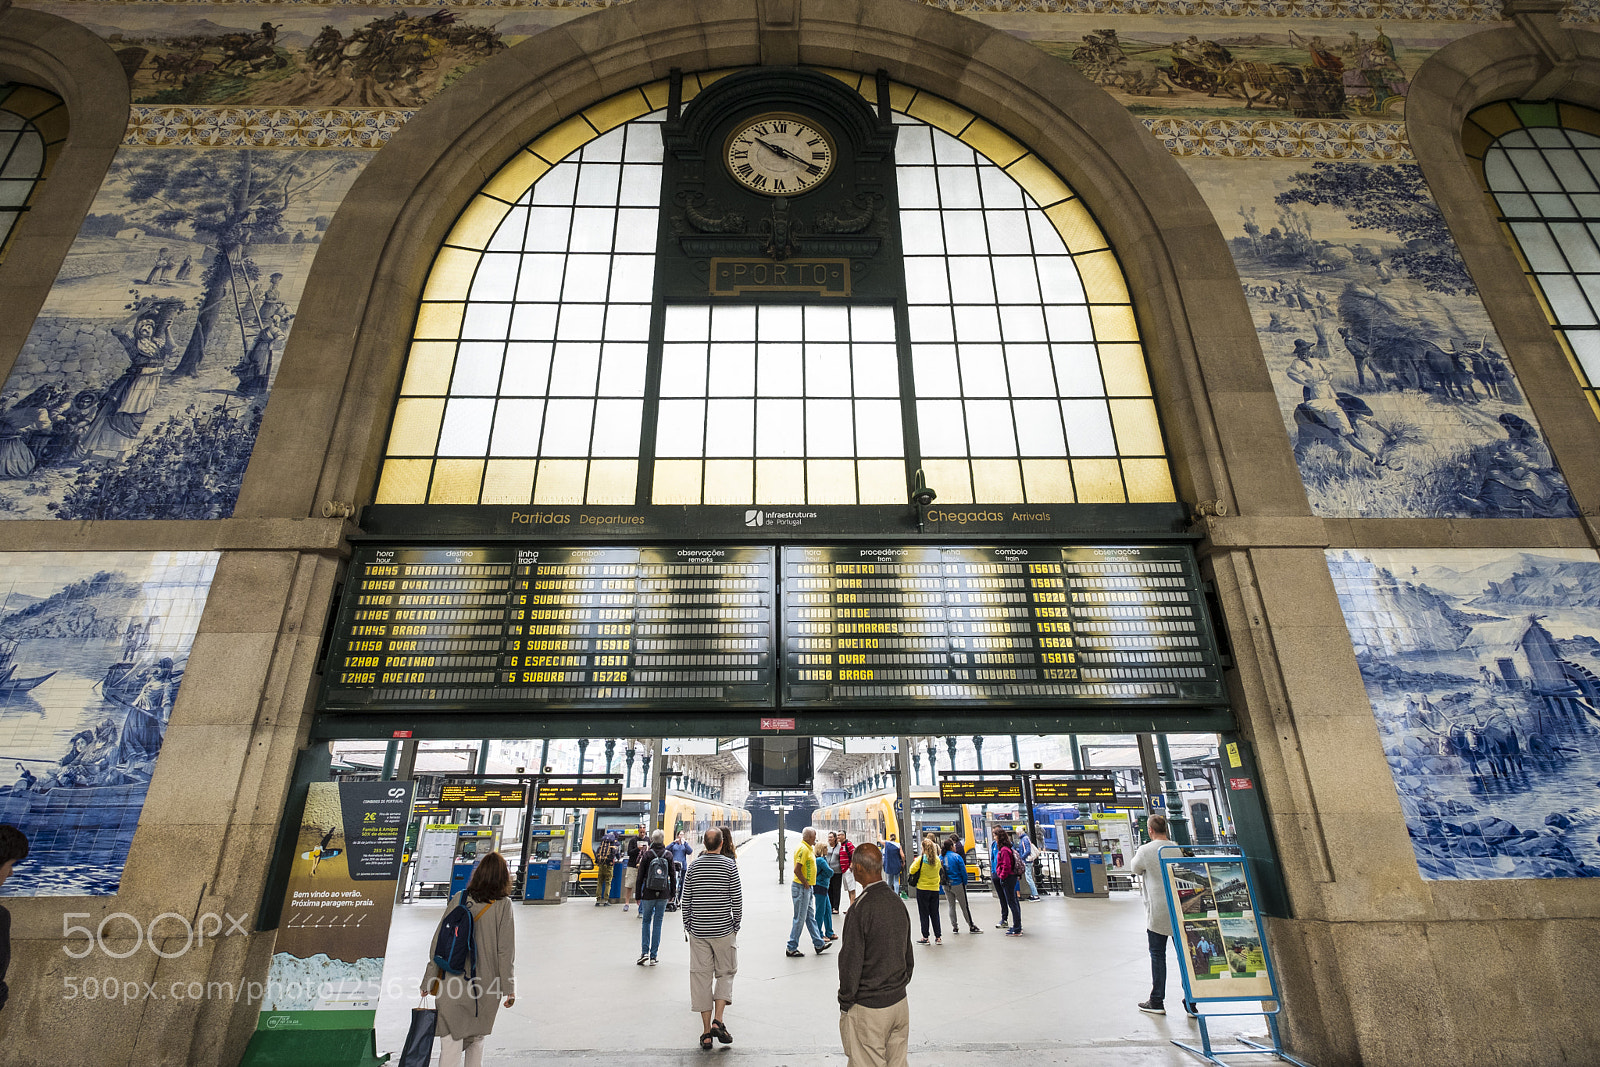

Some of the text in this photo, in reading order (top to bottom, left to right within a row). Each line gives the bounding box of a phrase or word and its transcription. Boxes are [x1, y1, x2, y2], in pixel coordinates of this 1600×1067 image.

[754, 126, 768, 136] XI
[773, 124, 786, 133] XII
[795, 128, 804, 136] I
[740, 138, 754, 146] X
[806, 138, 820, 146] II
[734, 150, 748, 158] IX
[812, 152, 825, 160] III
[738, 163, 754, 178] VIII
[752, 174, 768, 187] VII
[774, 179, 785, 189] VI
[796, 176, 806, 186] V
[733, 264, 826, 284] PORTO
[511, 512, 645, 526] Partidas Departures
[928, 510, 1051, 524] Chegadas Arrivals
[677, 550, 724, 558] observações
[365, 566, 398, 575] 10H45
[404, 566, 438, 575] BRAGA
[525, 566, 530, 575] 1
[836, 564, 874, 574] AVEIRO
[1029, 564, 1060, 573] 15616
[361, 580, 395, 590] 10H50
[402, 580, 428, 590] OVAR
[522, 580, 528, 590] 4
[836, 579, 862, 588] OVAR
[358, 595, 392, 604] 11H00
[399, 595, 452, 604] PENAFIEL
[520, 595, 526, 604] 5
[533, 595, 574, 604] SUBURB
[837, 594, 856, 602] BRA
[1033, 593, 1066, 602] 15220
[354, 610, 389, 620] 11H05
[396, 610, 437, 620] AVEIRO
[518, 610, 524, 620] 3
[531, 610, 571, 620] SUBURB
[1035, 608, 1068, 617] 15522
[352, 626, 386, 635] 11H45
[392, 626, 426, 635] BRAGA
[516, 626, 522, 635] 4
[529, 626, 570, 634] SUBURB
[838, 623, 898, 633] GUIMARAES
[1037, 622, 1070, 632] 15158
[348, 640, 630, 650] 11H50 OVAR 3 SUBURB 15918
[838, 638, 878, 648] AVEIRO
[1040, 638, 1073, 648] 15620
[345, 656, 628, 666] 12H00 POCINHO 6 ESPECIAL 13511
[839, 654, 866, 664] OVAR
[1042, 654, 1076, 664] 15816
[340, 672, 627, 683] 12H05 AVEIRO 5 SUBURB 15726
[840, 670, 874, 680] BRAGA
[976, 669, 1016, 680] SUBURB
[1044, 669, 1078, 680] 15222
[364, 812, 376, 820] 2€
[321, 900, 354, 908] paragem:
[355, 899, 374, 908] praia.
